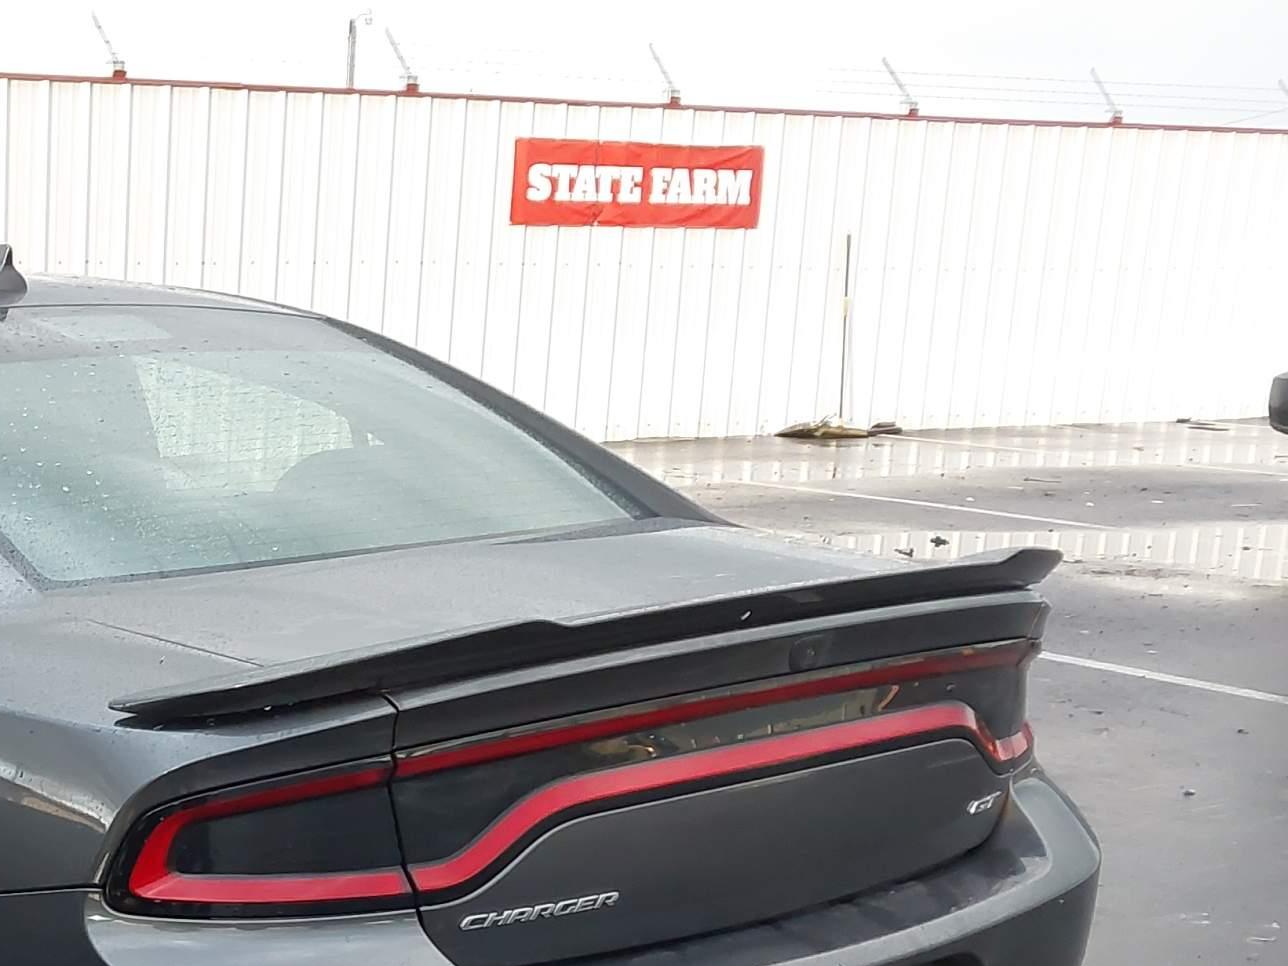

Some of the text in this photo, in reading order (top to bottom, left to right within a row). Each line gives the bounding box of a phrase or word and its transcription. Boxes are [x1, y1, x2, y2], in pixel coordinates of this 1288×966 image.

[525, 163, 753, 206] STATE FARM
[459, 891, 620, 931] CHARGER
